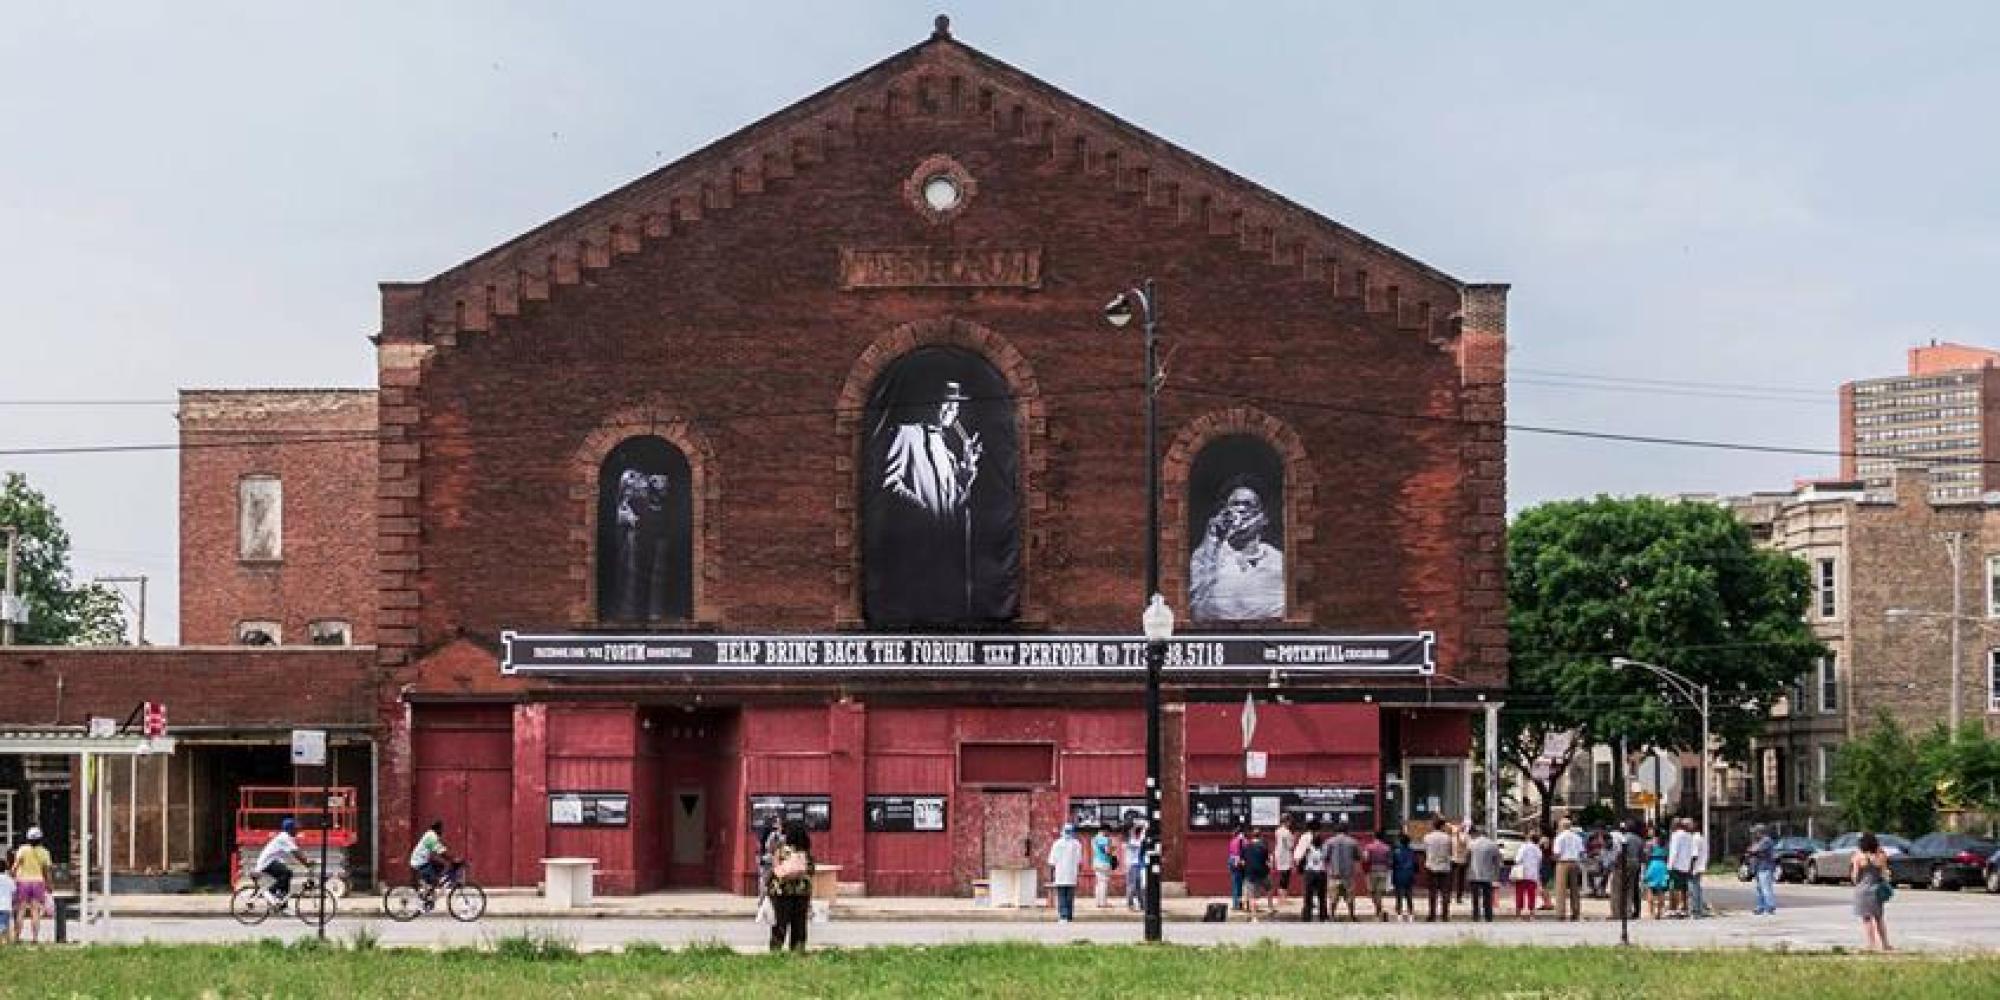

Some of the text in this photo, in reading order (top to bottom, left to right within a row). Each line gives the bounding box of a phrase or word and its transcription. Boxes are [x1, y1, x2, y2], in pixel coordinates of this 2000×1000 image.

[717, 641, 760, 663] HELP
[766, 641, 818, 663] BRING
[823, 641, 867, 663] BACK
[871, 641, 905, 663] THE
[911, 641, 975, 663] FORUM!
[1019, 642, 1099, 665] PERFORM
